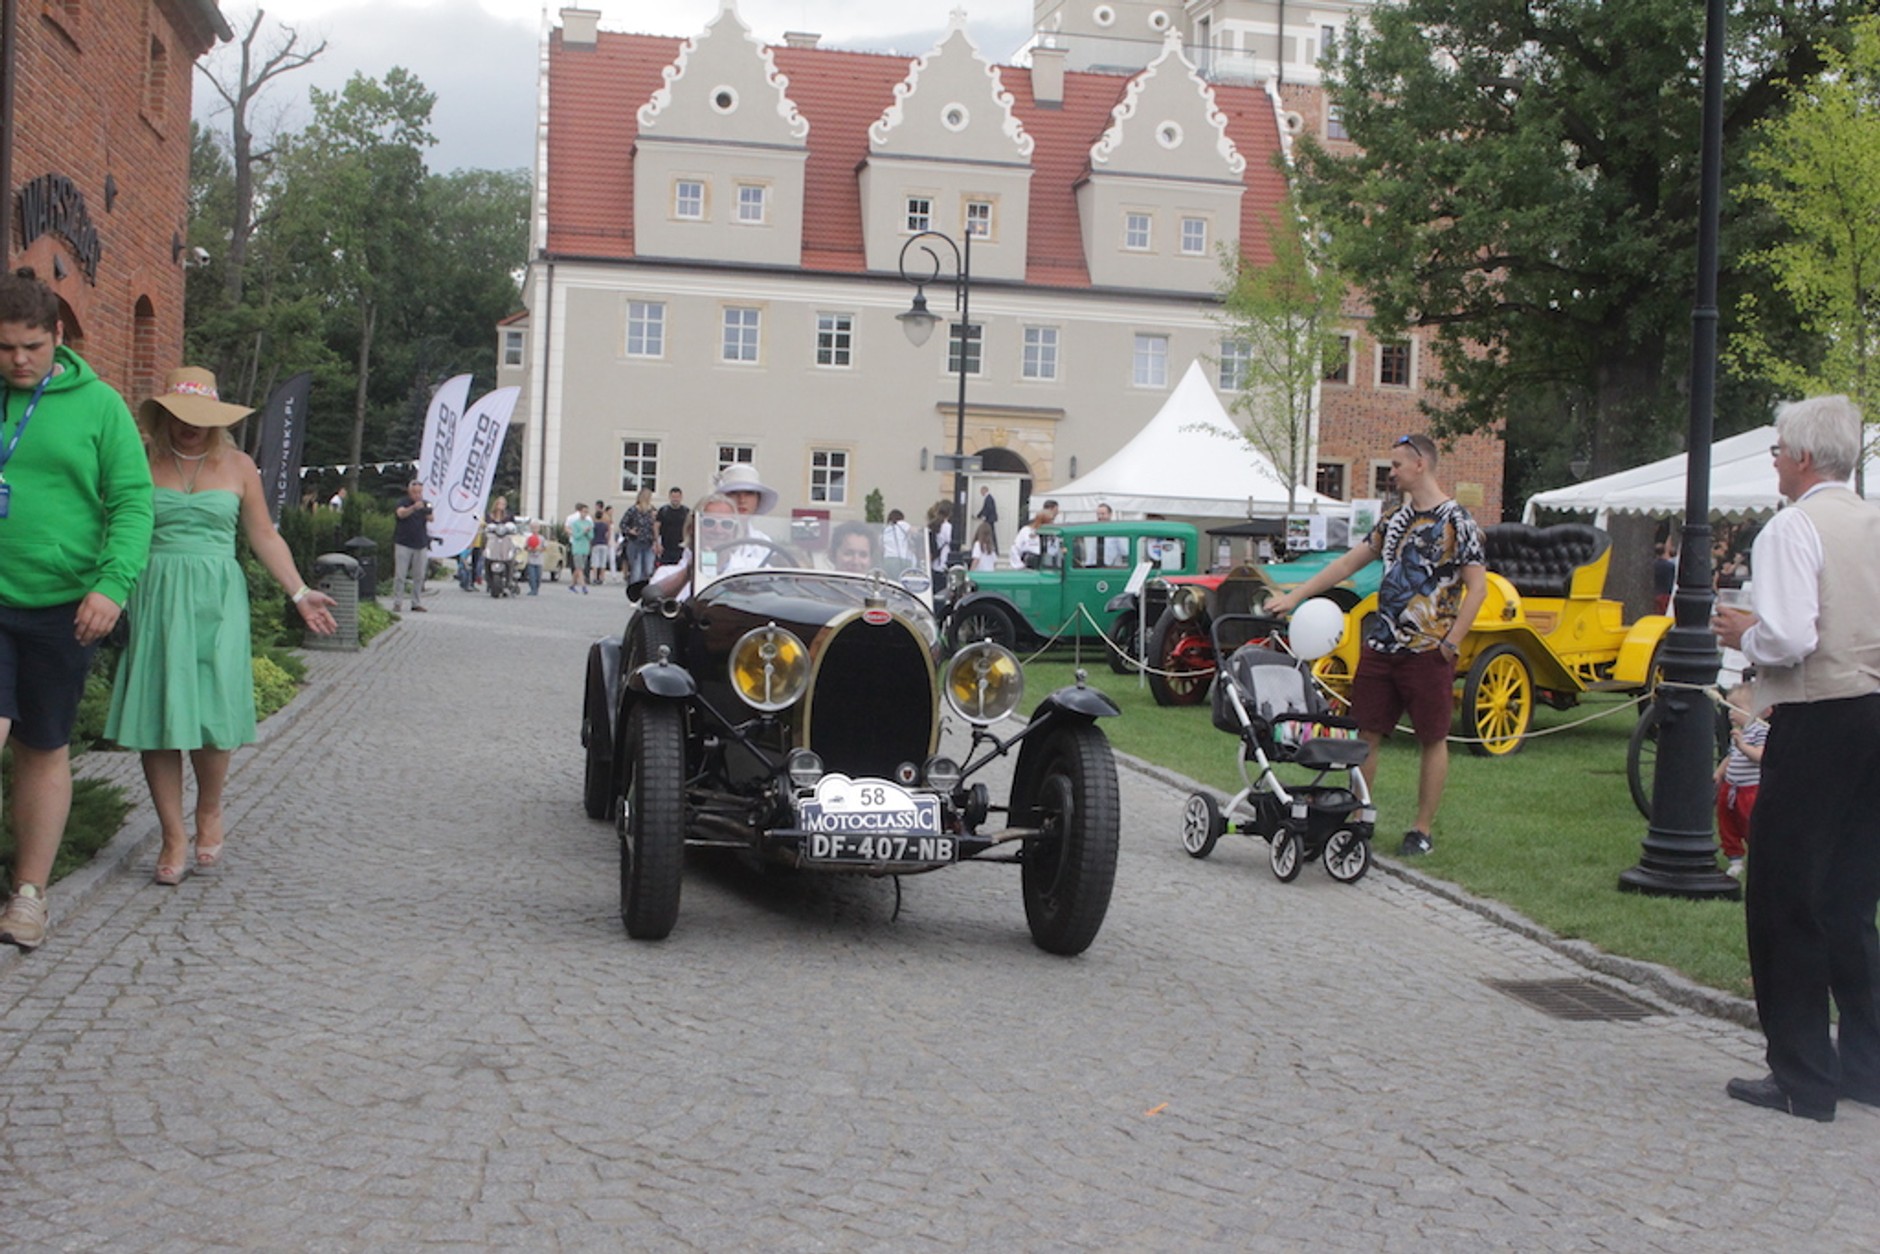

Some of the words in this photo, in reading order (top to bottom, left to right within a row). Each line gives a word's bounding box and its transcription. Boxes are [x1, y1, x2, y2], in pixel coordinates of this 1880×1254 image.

[860, 787, 886, 807] 58
[807, 808, 933, 832] MOTOCLASSIC
[811, 834, 954, 861] DF-407-NB
